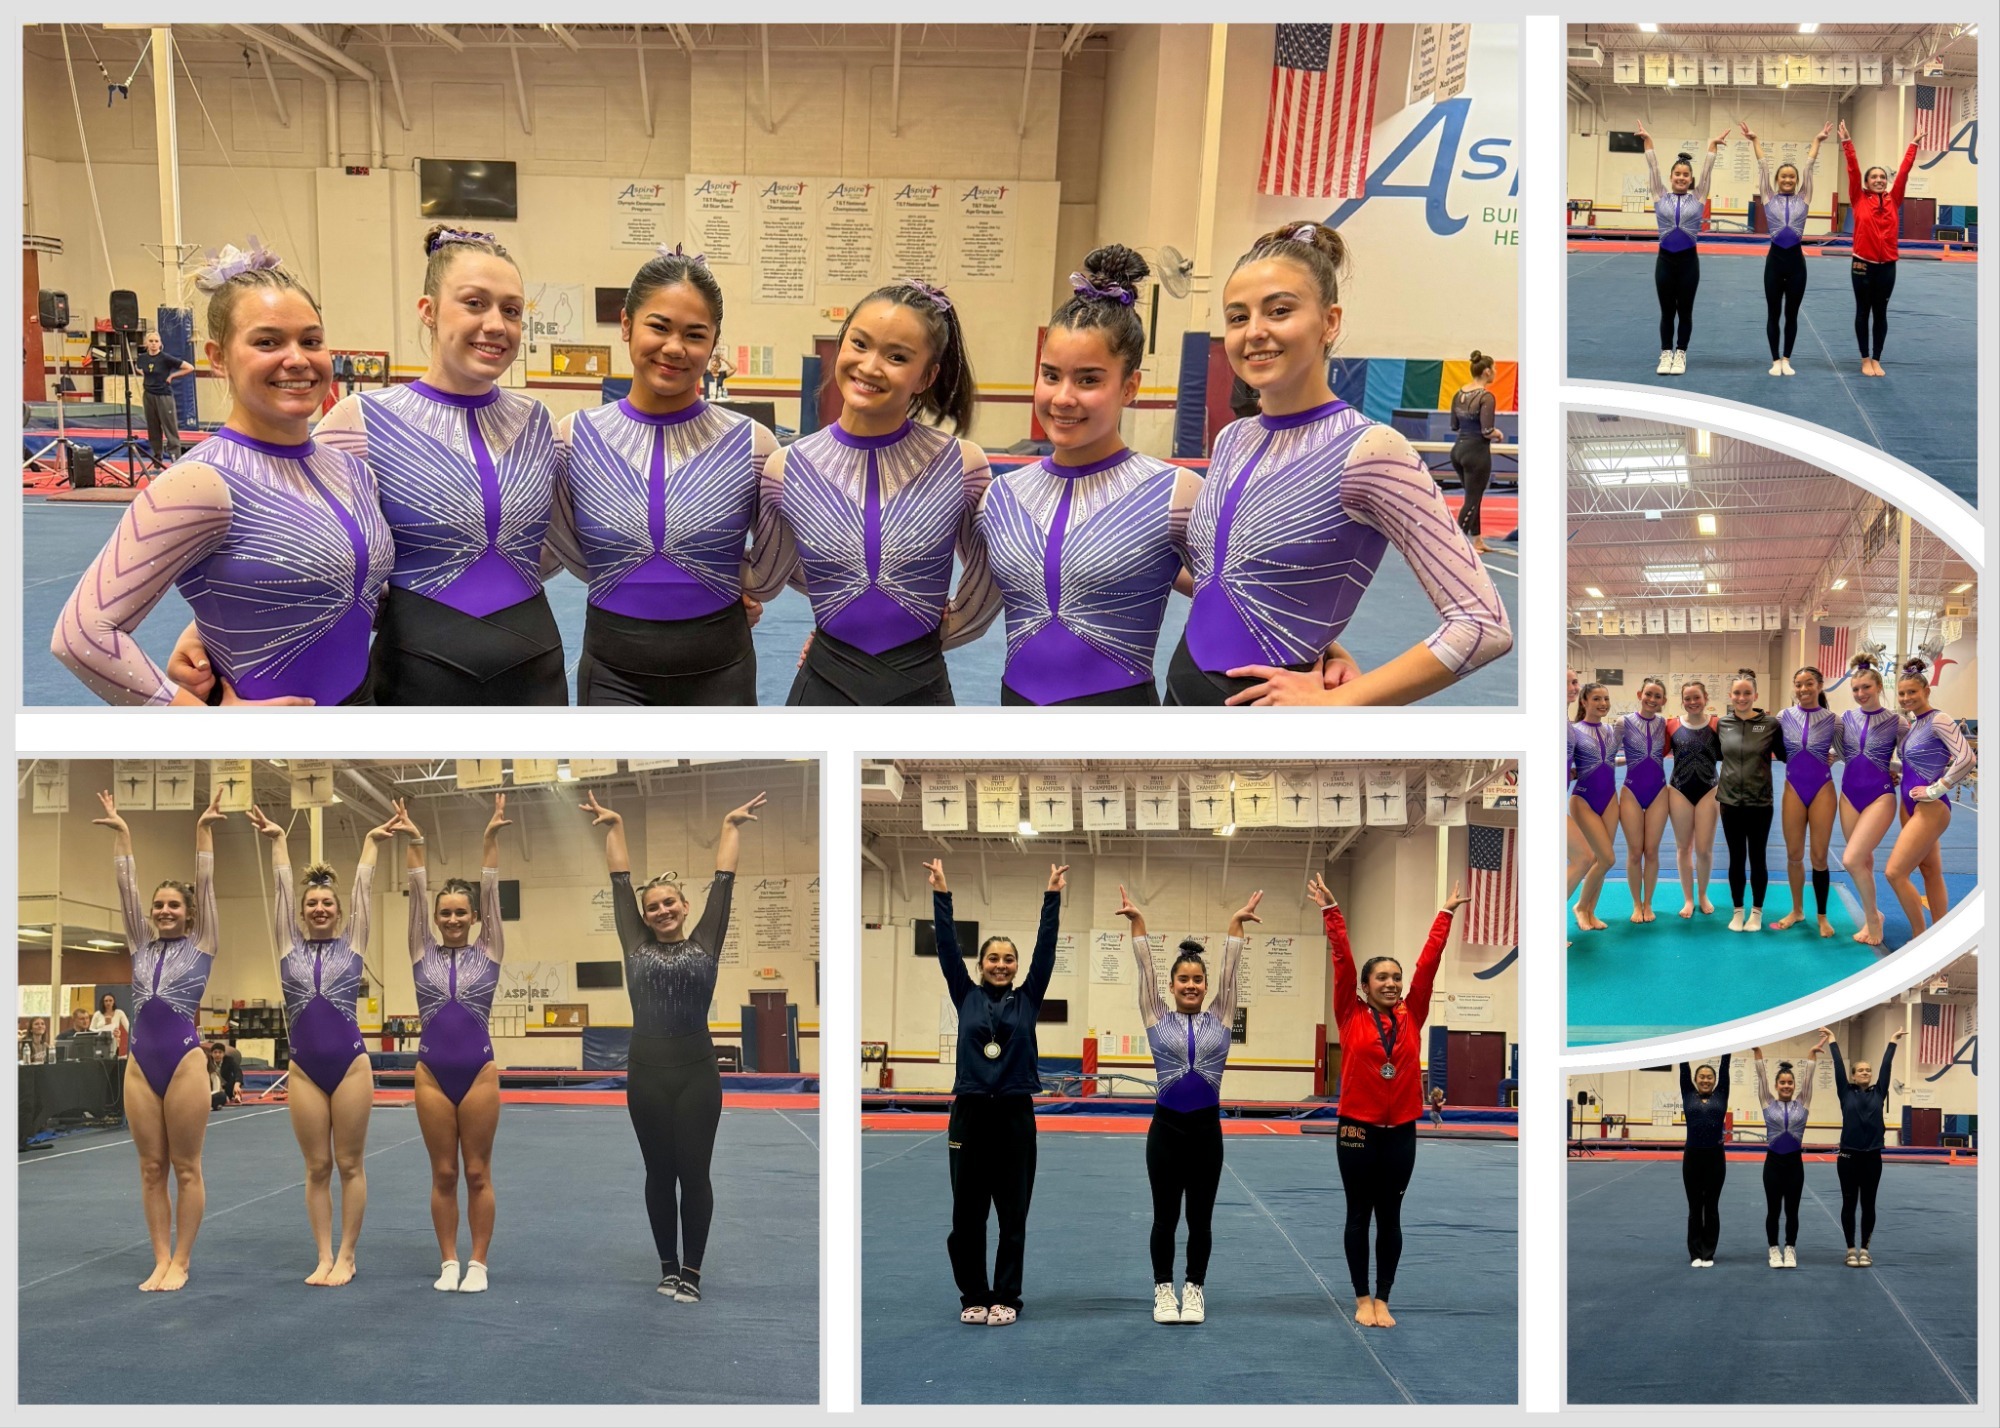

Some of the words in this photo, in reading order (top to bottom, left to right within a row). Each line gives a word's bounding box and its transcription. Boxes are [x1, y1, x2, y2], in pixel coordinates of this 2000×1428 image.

[760, 181, 798, 198] Aspire
[826, 183, 865, 200] Aspire
[893, 184, 932, 200] Aspire
[960, 185, 999, 202] Aspire
